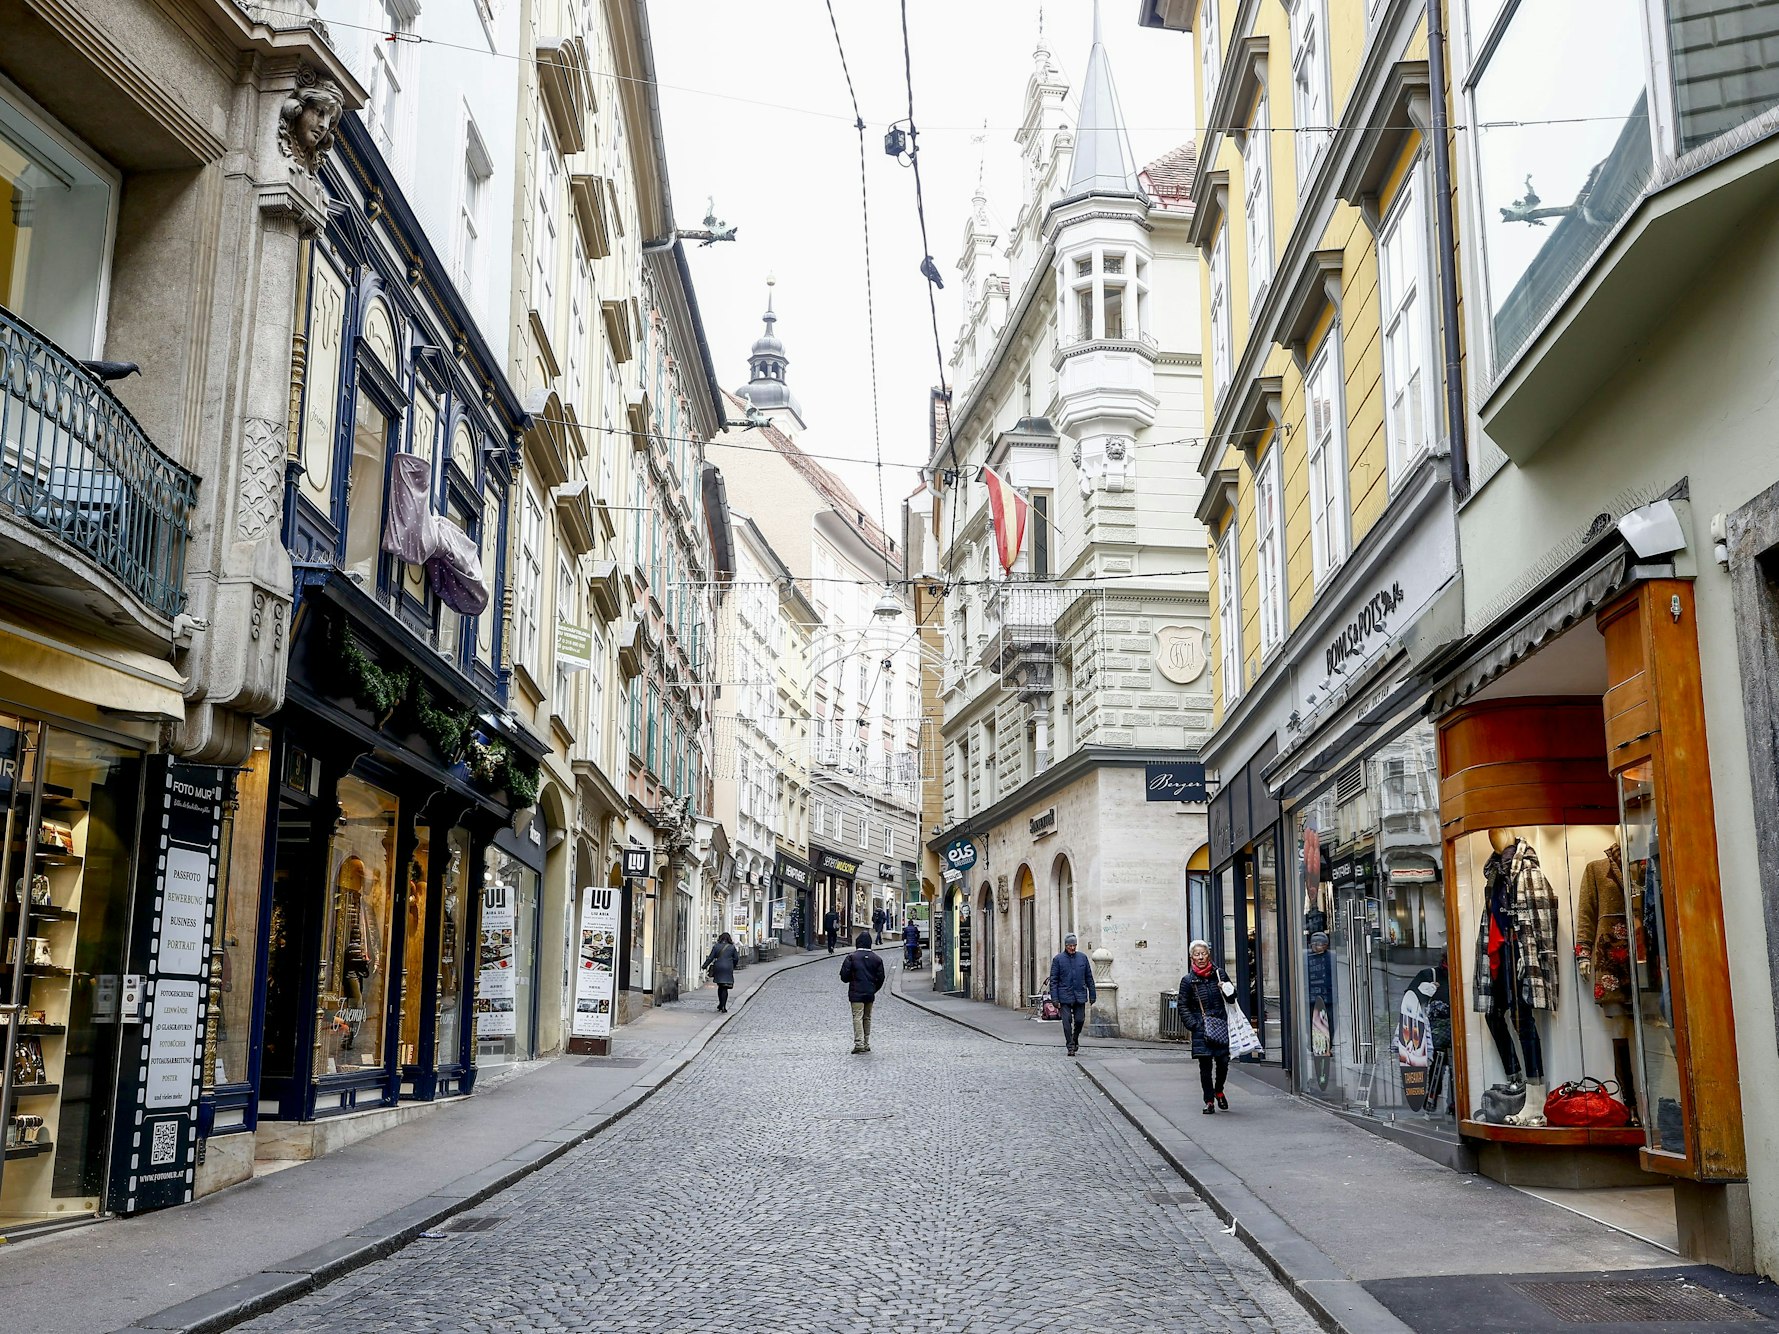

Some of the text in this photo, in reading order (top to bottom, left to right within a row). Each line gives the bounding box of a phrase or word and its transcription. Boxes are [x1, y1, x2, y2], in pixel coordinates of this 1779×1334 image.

[172, 781, 194, 796] FOTO
[1149, 773, 1202, 796] Berger
[628, 853, 645, 871] LIU
[173, 869, 201, 882] PASSFOTO
[167, 892, 203, 905] BEWERBUNG
[591, 889, 612, 910] LIU
[170, 916, 197, 928] BUSINESS
[167, 940, 196, 951] PORTRAIT
[163, 1005, 188, 1014] LEINWÄNDE
